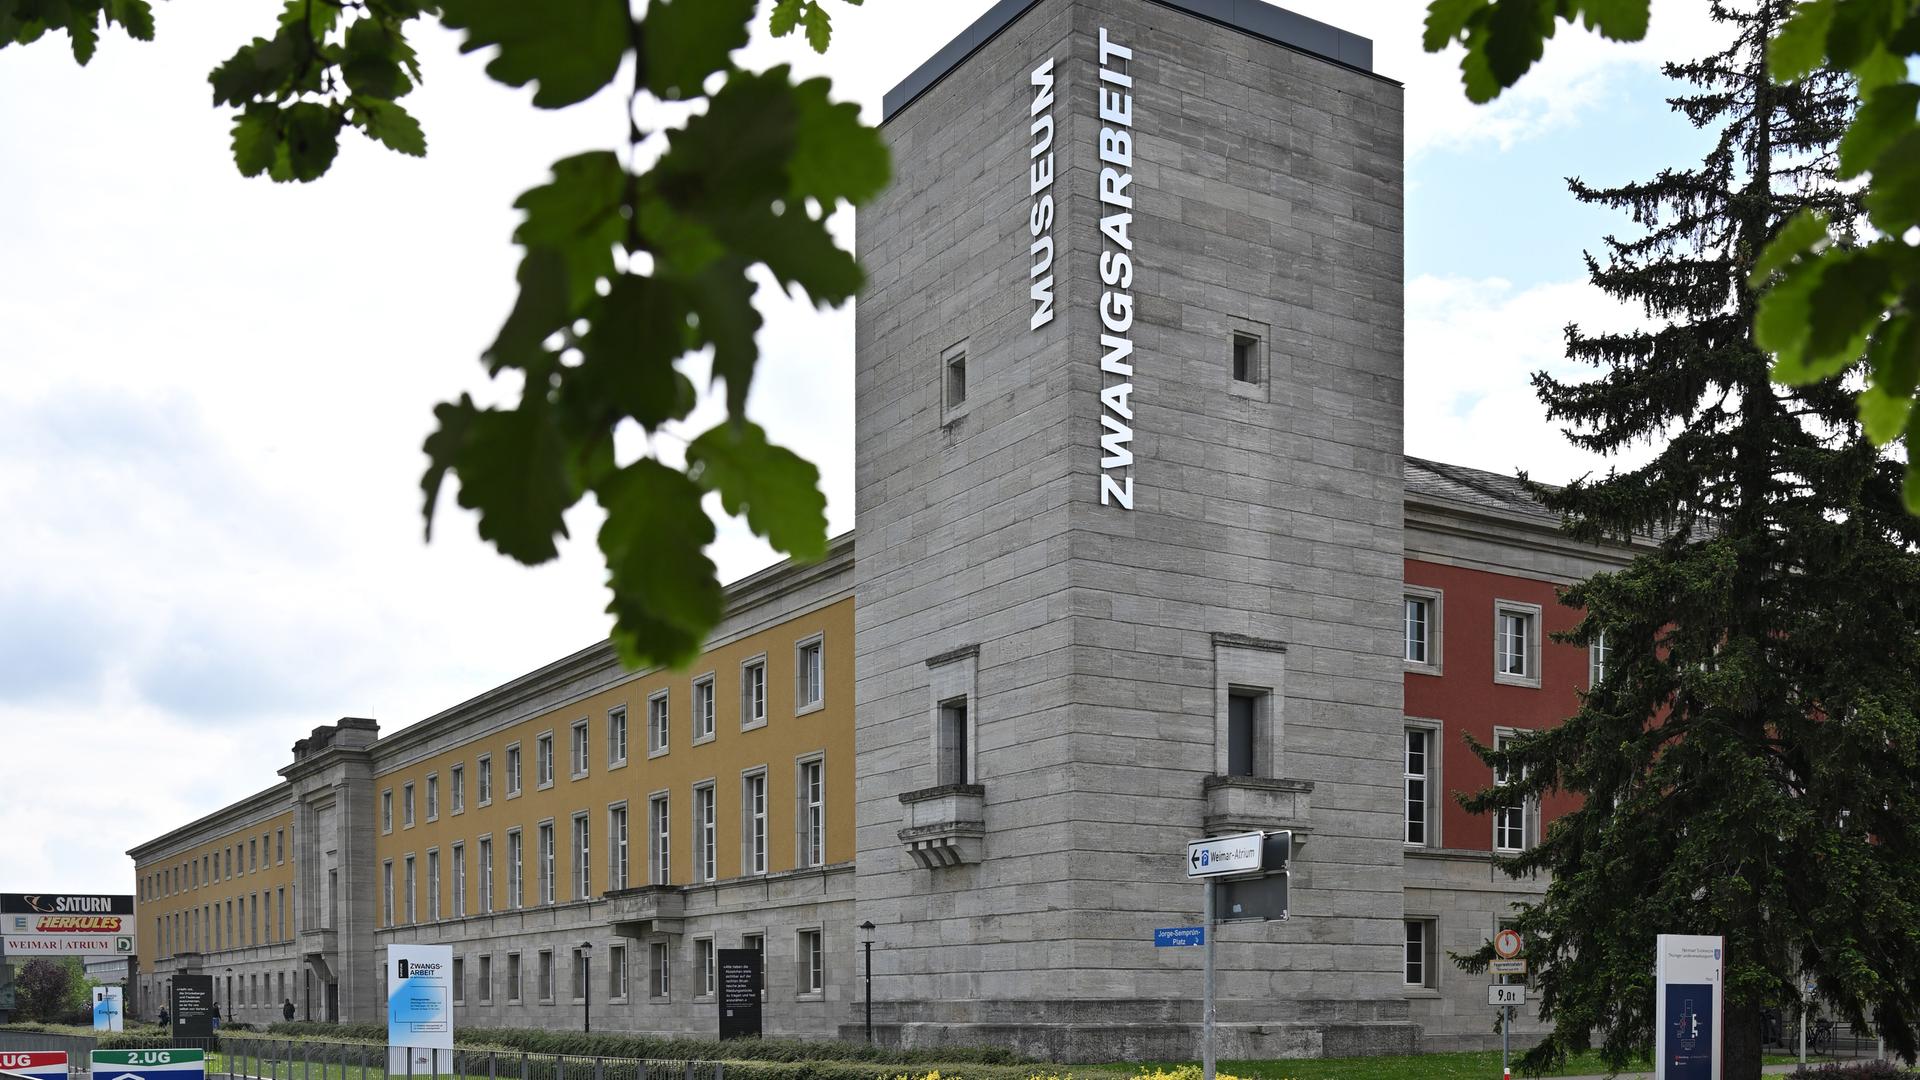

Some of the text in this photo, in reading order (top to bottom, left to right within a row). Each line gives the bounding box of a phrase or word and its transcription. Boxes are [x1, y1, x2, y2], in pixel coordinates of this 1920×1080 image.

[1031, 57, 1054, 331] MUSEUM
[1100, 27, 1133, 509] ZWANGSARBEIT
[1210, 848, 1255, 862] Weimar-Atrium
[56, 896, 112, 912] SATURN
[36, 915, 122, 932] HERKULES
[9, 941, 108, 949] WEIMAR ATRIUM
[127, 1051, 171, 1064] 2.UG
